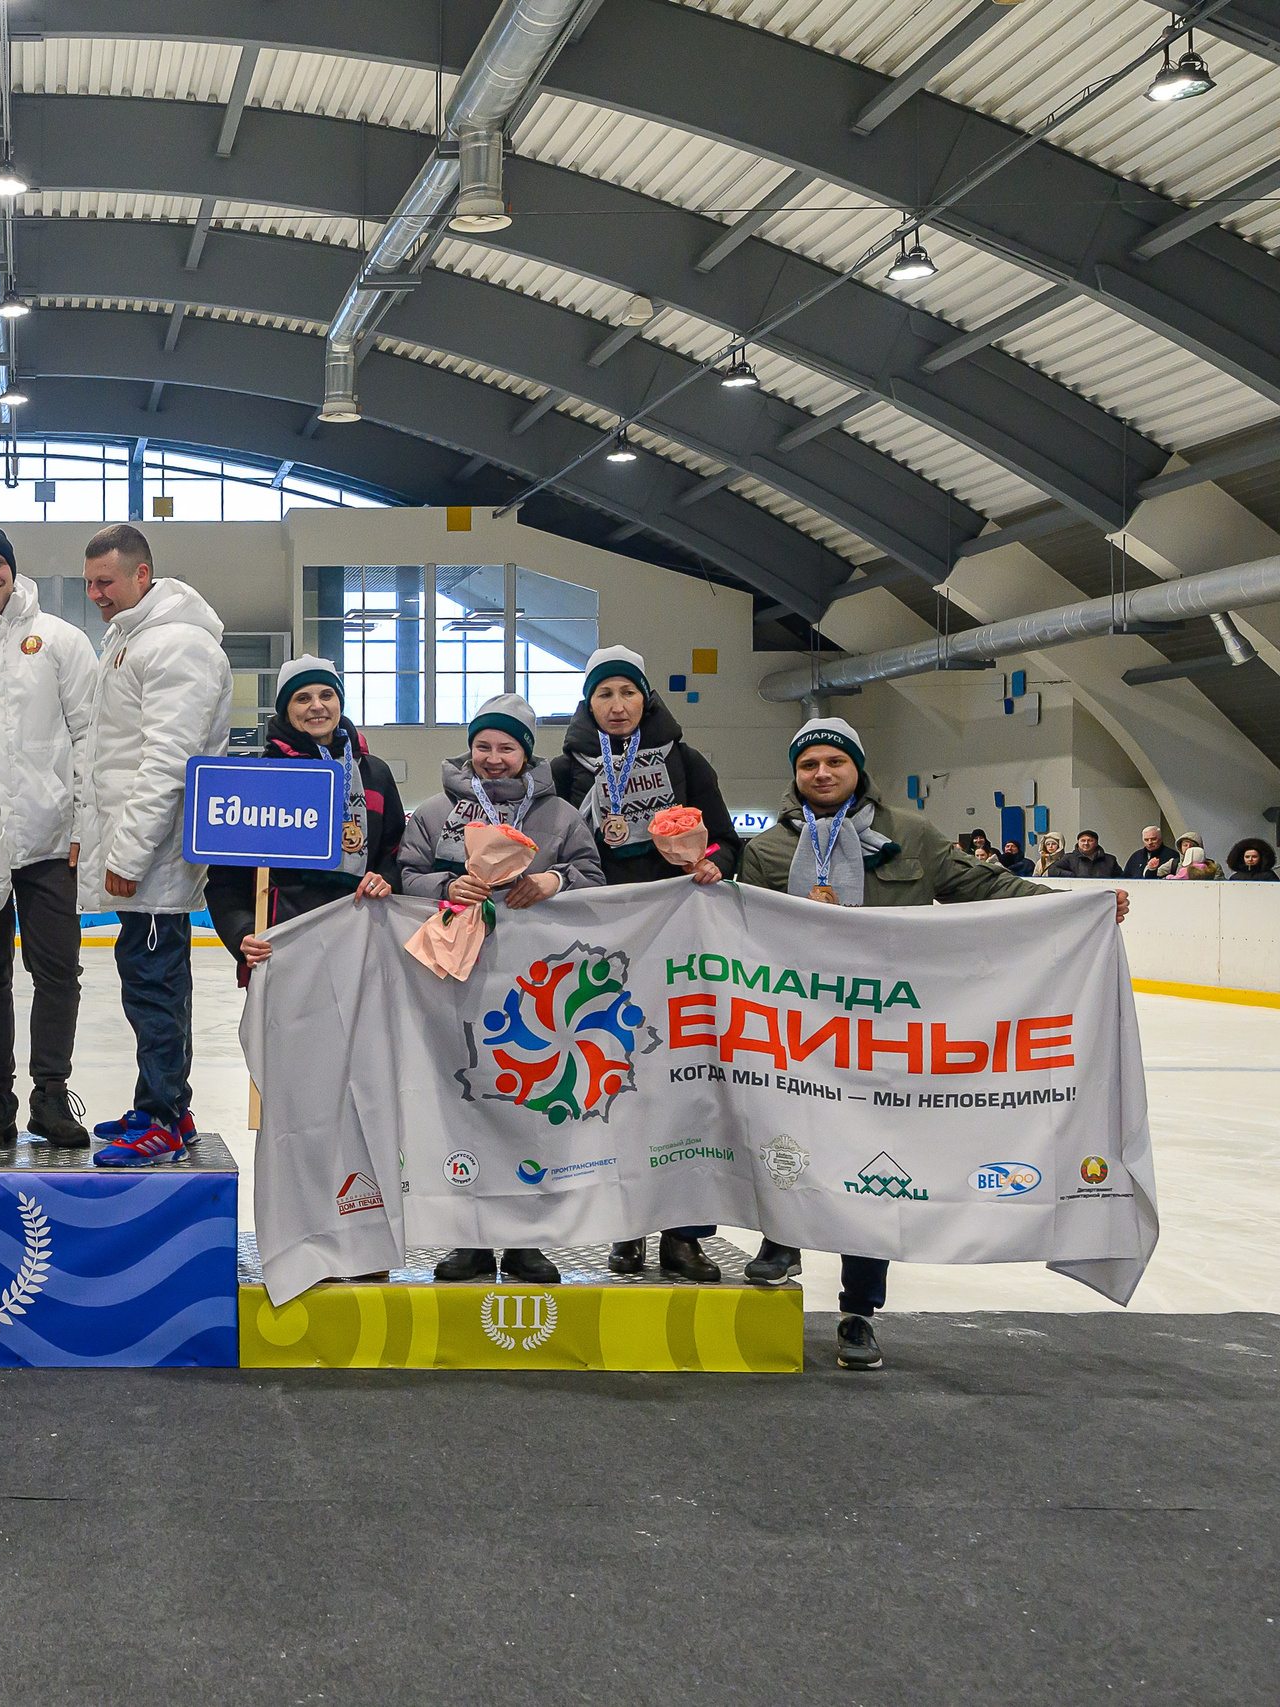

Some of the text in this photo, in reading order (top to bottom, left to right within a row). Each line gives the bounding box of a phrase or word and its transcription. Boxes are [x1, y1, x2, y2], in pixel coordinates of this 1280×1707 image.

[797, 732, 844, 747] БЕЛАРУСЬ
[601, 772, 665, 798] ЕИНЫЕ
[207, 795, 319, 829] Единые
[666, 953, 922, 1014] КОМАНДА
[668, 993, 1075, 1075] ЕДИНЫЕ
[670, 1064, 727, 1083] КОГДА
[732, 1069, 769, 1087] МЫ
[776, 1075, 842, 1101] ЕДИНЫ
[873, 1091, 911, 1107] МЫ
[918, 1087, 1077, 1109] НЕПОБЕДИМЫ!
[685, 1138, 702, 1146] Дом
[551, 1157, 618, 1175] ПРОМТРАНСИНВЕСТ
[649, 1146, 735, 1168] ВОСТОЧНЫЙ
[338, 1197, 384, 1213] ДОМ ПЕЧАТИ
[494, 1295, 545, 1329] III
